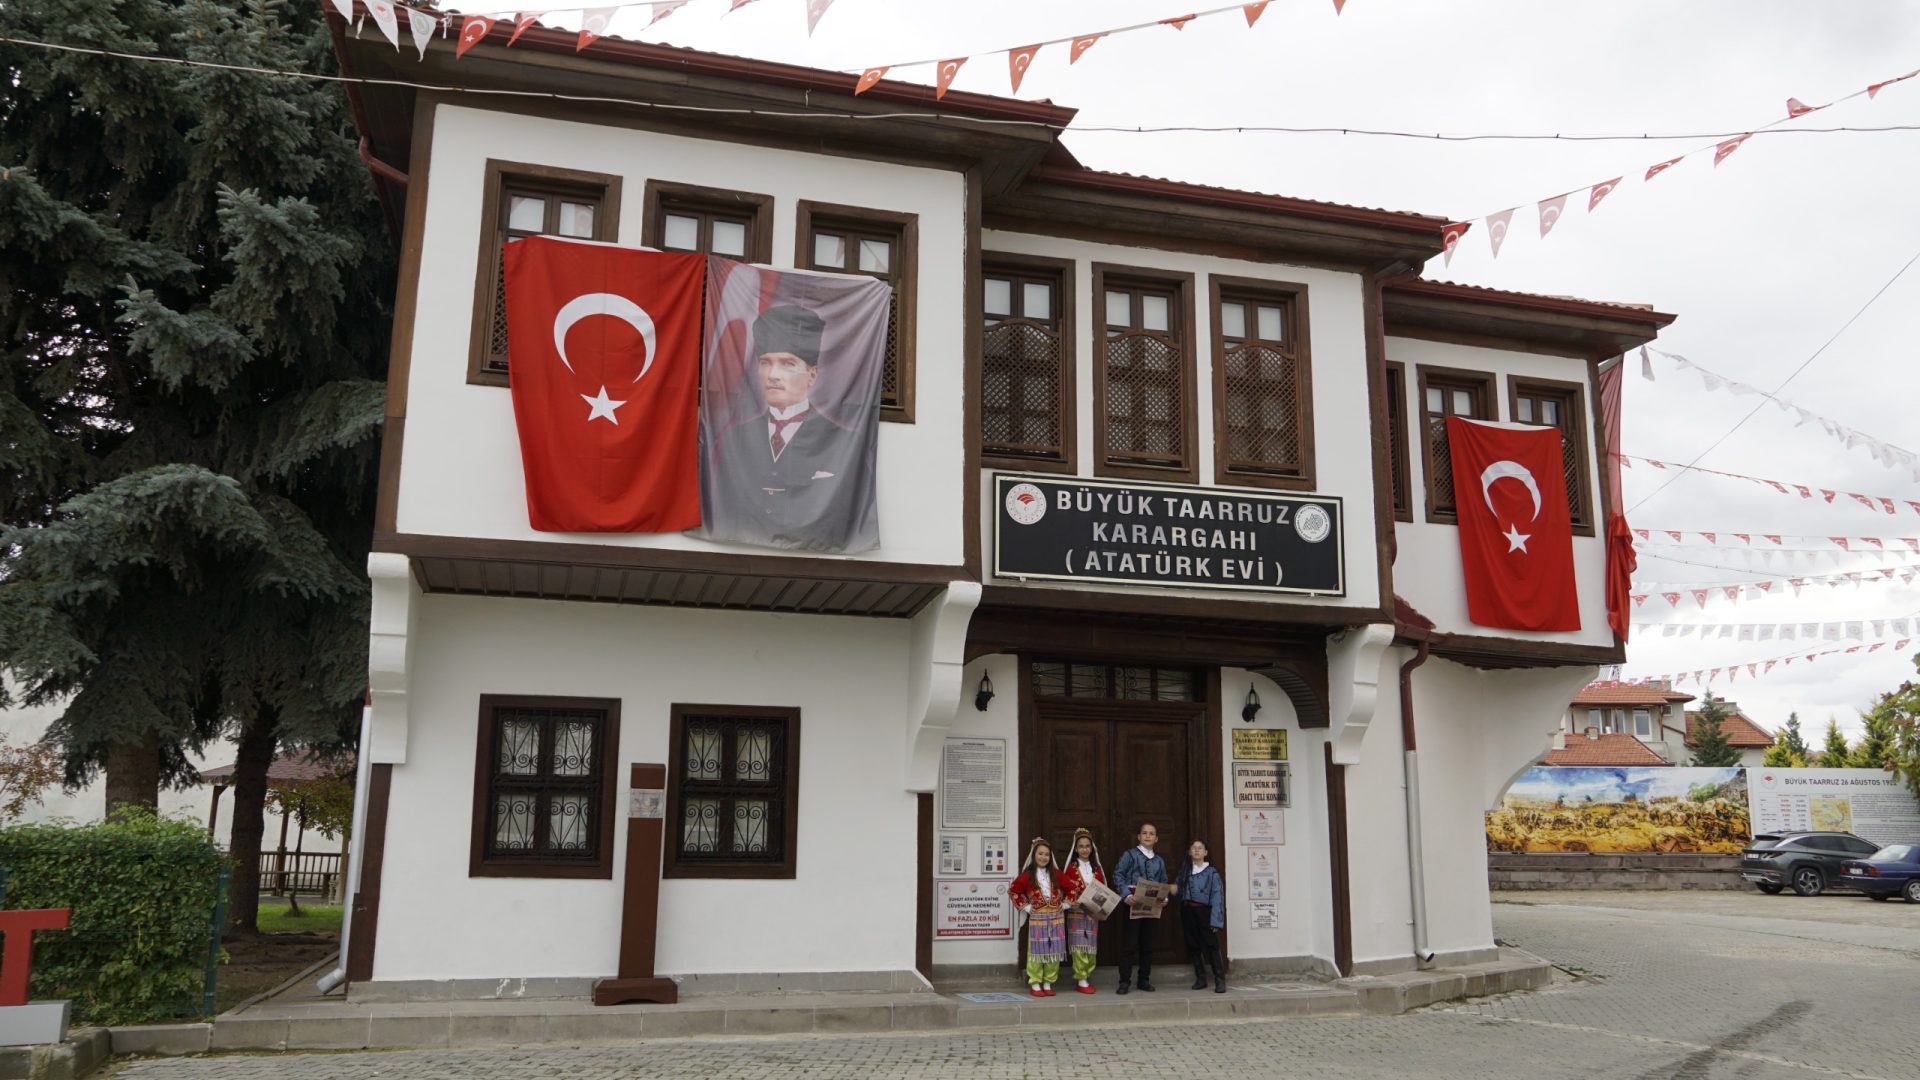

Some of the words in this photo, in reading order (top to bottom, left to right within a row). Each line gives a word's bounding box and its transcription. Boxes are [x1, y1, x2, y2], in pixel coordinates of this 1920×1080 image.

[1057, 487, 1153, 515] BÜYÜK
[1163, 497, 1290, 526] TAARRUZ
[1092, 522, 1257, 551] KARARGAHI
[1084, 551, 1211, 577] ATATÜRK
[1222, 556, 1264, 581] EVİ
[1244, 779, 1270, 789] ATATÜRK
[1784, 777, 1808, 785] BÜYÜK
[1808, 778, 1840, 786] TAARRUZ
[1849, 777, 1881, 786] AĞUSTOS
[987, 914, 1000, 922] KİŞİ
